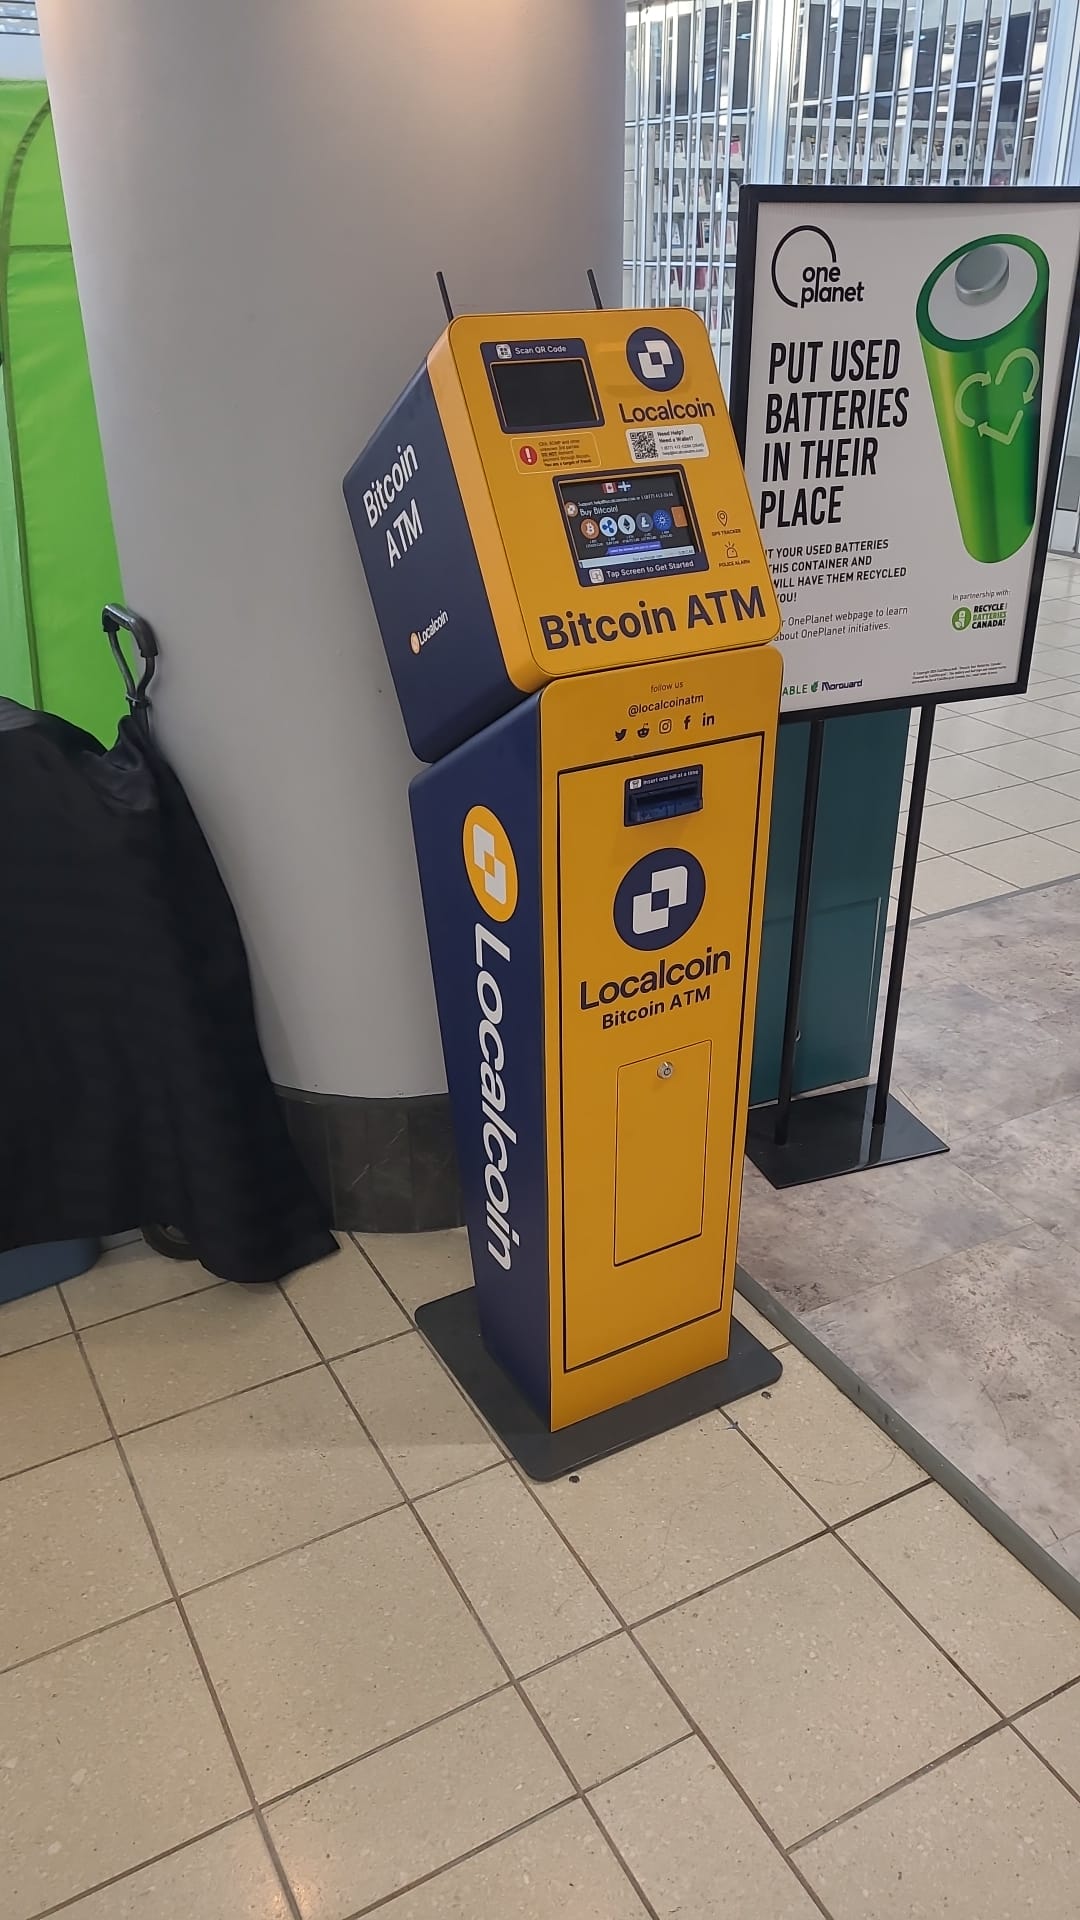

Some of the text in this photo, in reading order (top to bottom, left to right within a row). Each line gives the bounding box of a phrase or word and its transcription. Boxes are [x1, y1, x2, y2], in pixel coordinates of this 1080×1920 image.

[802, 266, 840, 282] one
[801, 281, 864, 308] planet
[514, 344, 567, 355] Scan QR Code
[769, 339, 900, 384] PUT USED
[619, 398, 715, 424] Localcoin
[765, 387, 909, 434] BATTERIES
[762, 437, 878, 482] IN THEIR
[362, 444, 419, 529] Bitcoin
[580, 505, 618, 517] Buy Bitcoin!
[759, 486, 844, 530] PLACE
[386, 498, 424, 569] ATM
[776, 546, 803, 559] YOUR
[806, 543, 831, 555] USED
[835, 539, 888, 553] BATTERIES
[606, 560, 694, 579] Tap Screen to Get Started
[791, 557, 848, 572] CONTAINER
[851, 555, 872, 566] AND
[797, 574, 824, 587] HAVE
[827, 572, 854, 583] THEM
[857, 567, 906, 581] RECYCLED
[960, 590, 995, 601] partnership
[540, 585, 766, 651] Bitcoin ATM
[788, 613, 833, 627] OnePlanet
[835, 611, 873, 624] webpage
[875, 608, 884, 618] to
[886, 606, 908, 616] learn
[973, 611, 1007, 621] BATTERIES
[974, 603, 1004, 613] RECYCLE
[418, 610, 448, 646] Localcoin
[801, 625, 845, 639] OnePlanet
[848, 622, 890, 634] initiatives.
[972, 619, 1006, 630] CANADA!
[651, 681, 684, 693] follow us
[628, 693, 704, 717] @localcoinatm
[580, 946, 731, 1010] Localcoin
[602, 985, 711, 1030] Bitcoin ATM
[474, 923, 520, 1271] Localcoin
